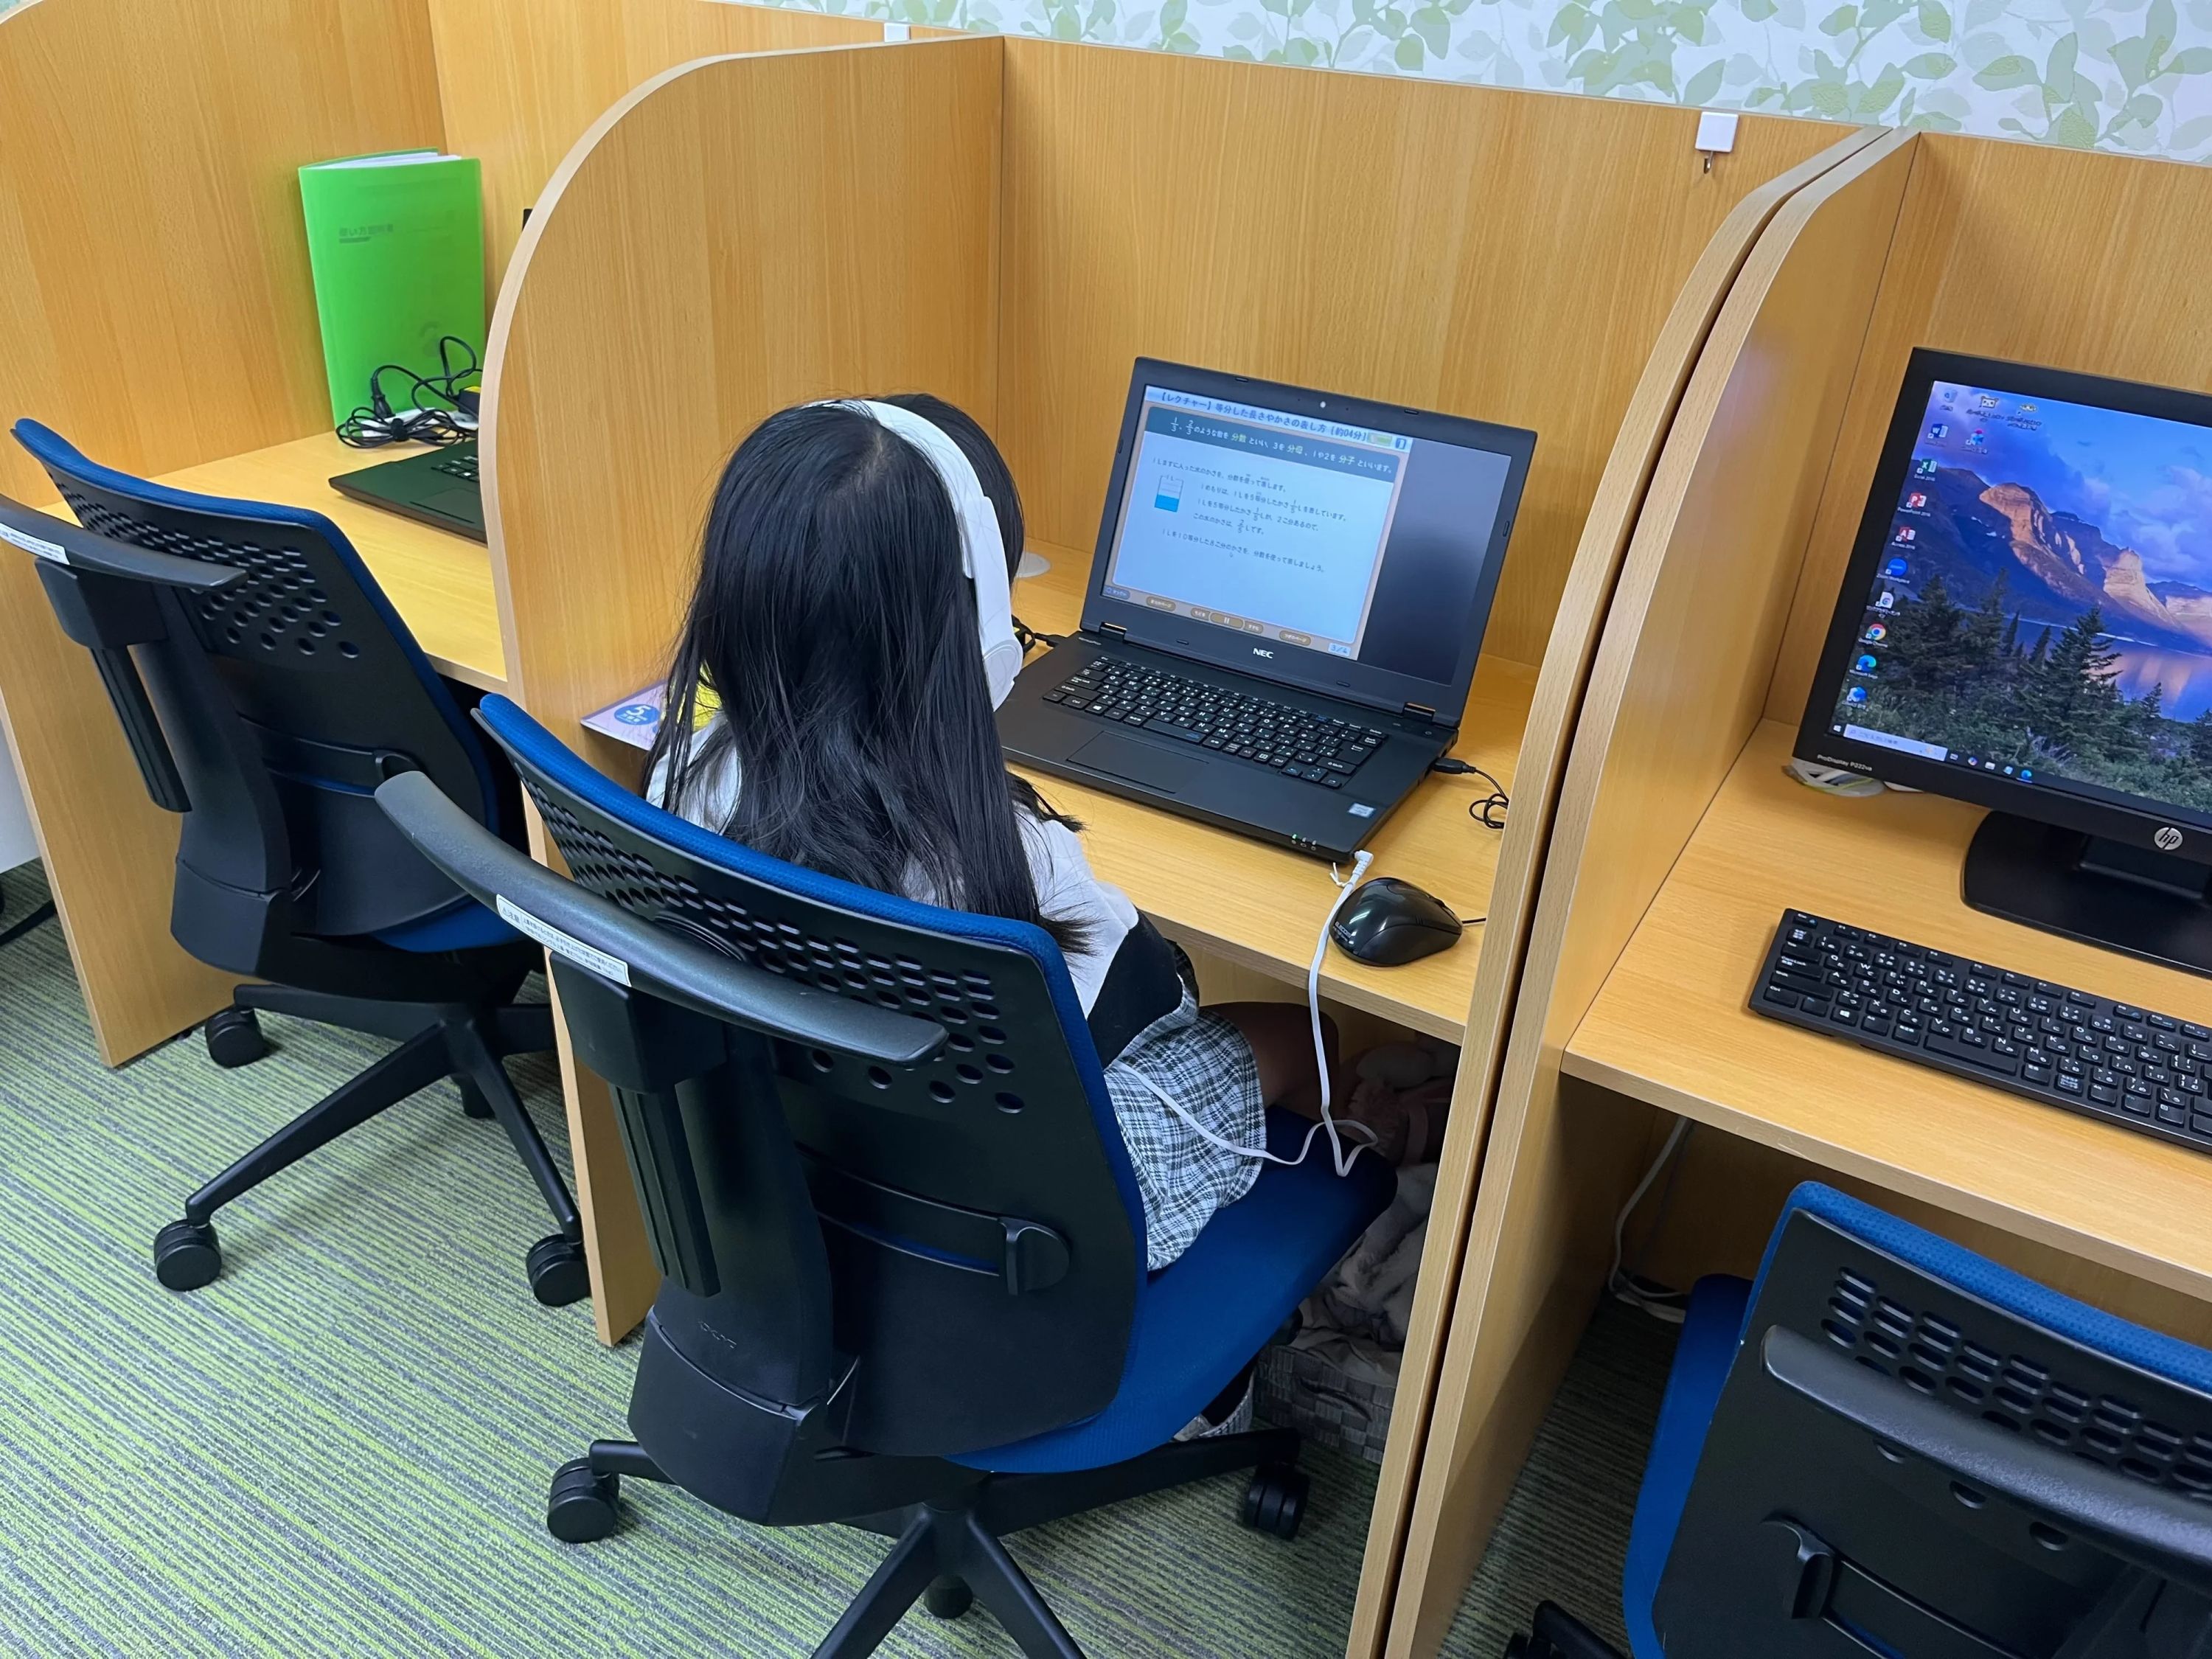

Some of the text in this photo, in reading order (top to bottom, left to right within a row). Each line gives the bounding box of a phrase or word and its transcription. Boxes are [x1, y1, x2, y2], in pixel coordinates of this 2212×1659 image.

[1231, 433, 1247, 443] 分数
[1338, 455, 1355, 465] 分子
[1253, 647, 1274, 659] NEC
[1329, 644, 1348, 654] 3/4
[1817, 754, 1849, 767] ProDisplay
